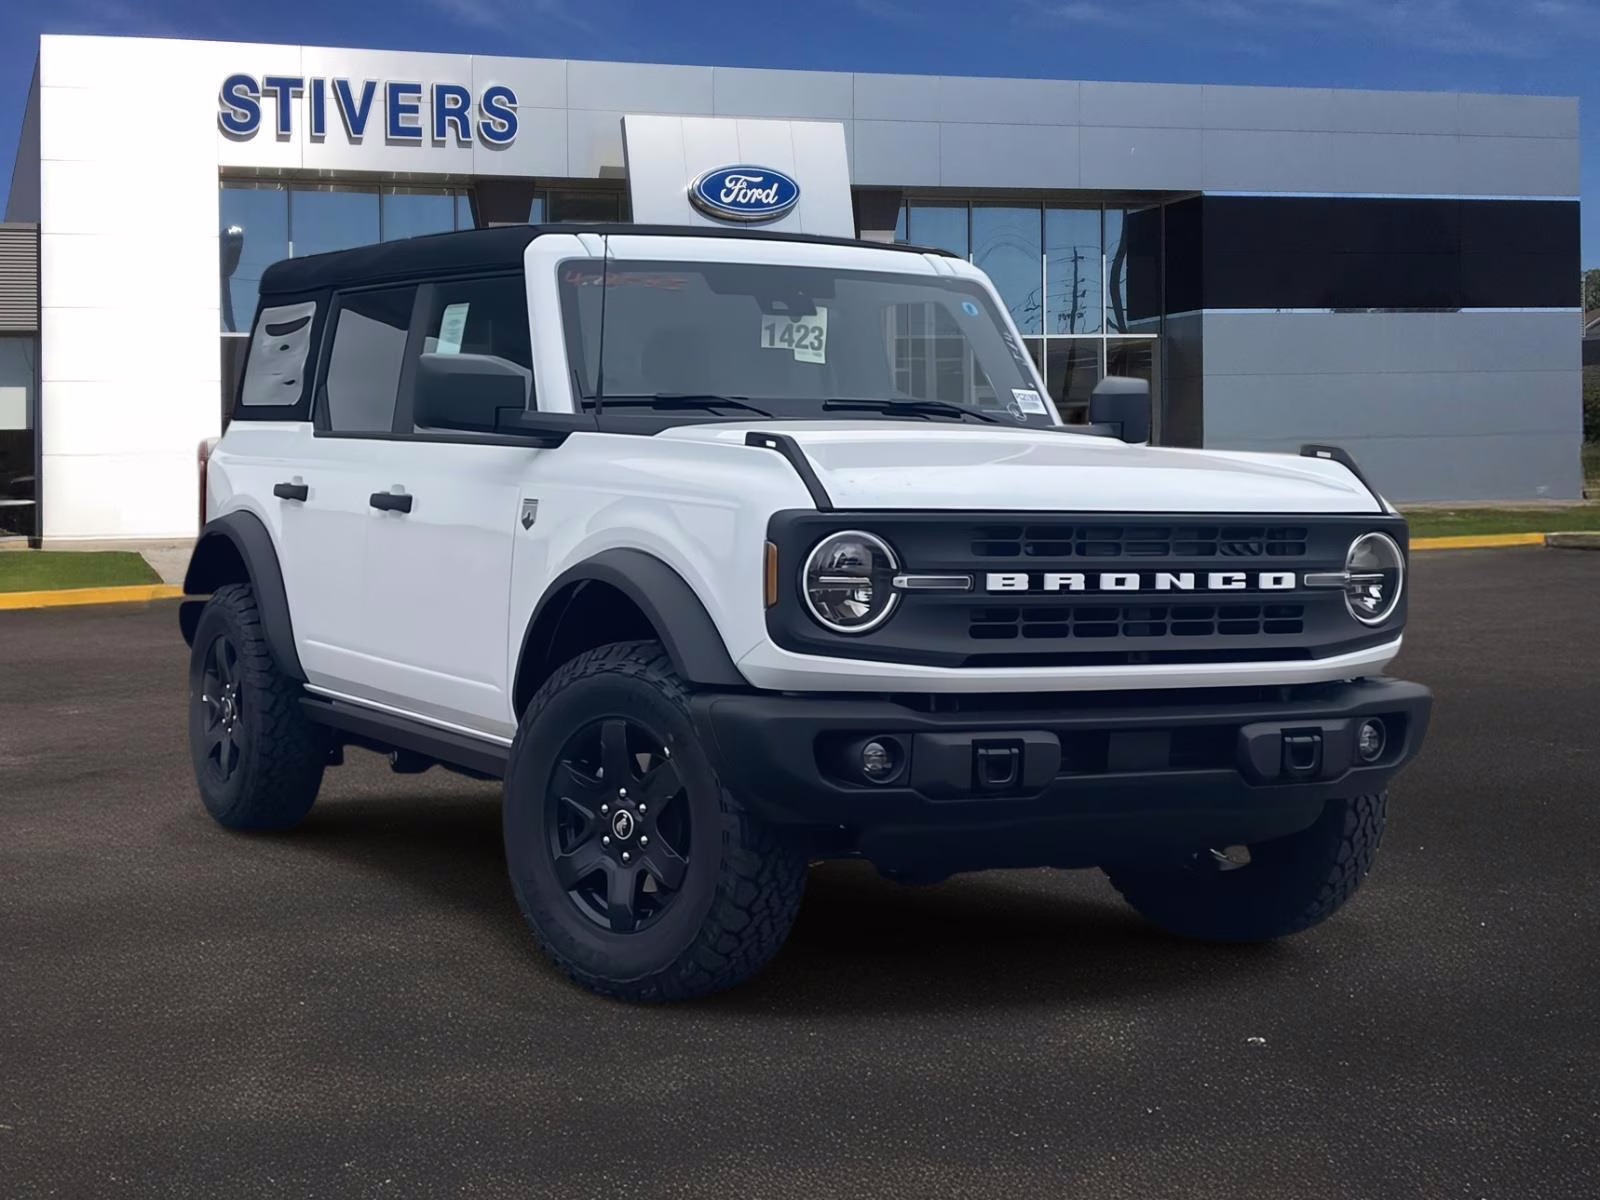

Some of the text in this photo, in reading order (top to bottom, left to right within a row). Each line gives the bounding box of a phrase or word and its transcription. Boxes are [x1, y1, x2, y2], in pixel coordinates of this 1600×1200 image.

[217, 72, 519, 148] STIVERS
[720, 174, 779, 204] Ford
[763, 322, 824, 351] 1423
[986, 572, 1297, 591] BRONCO
